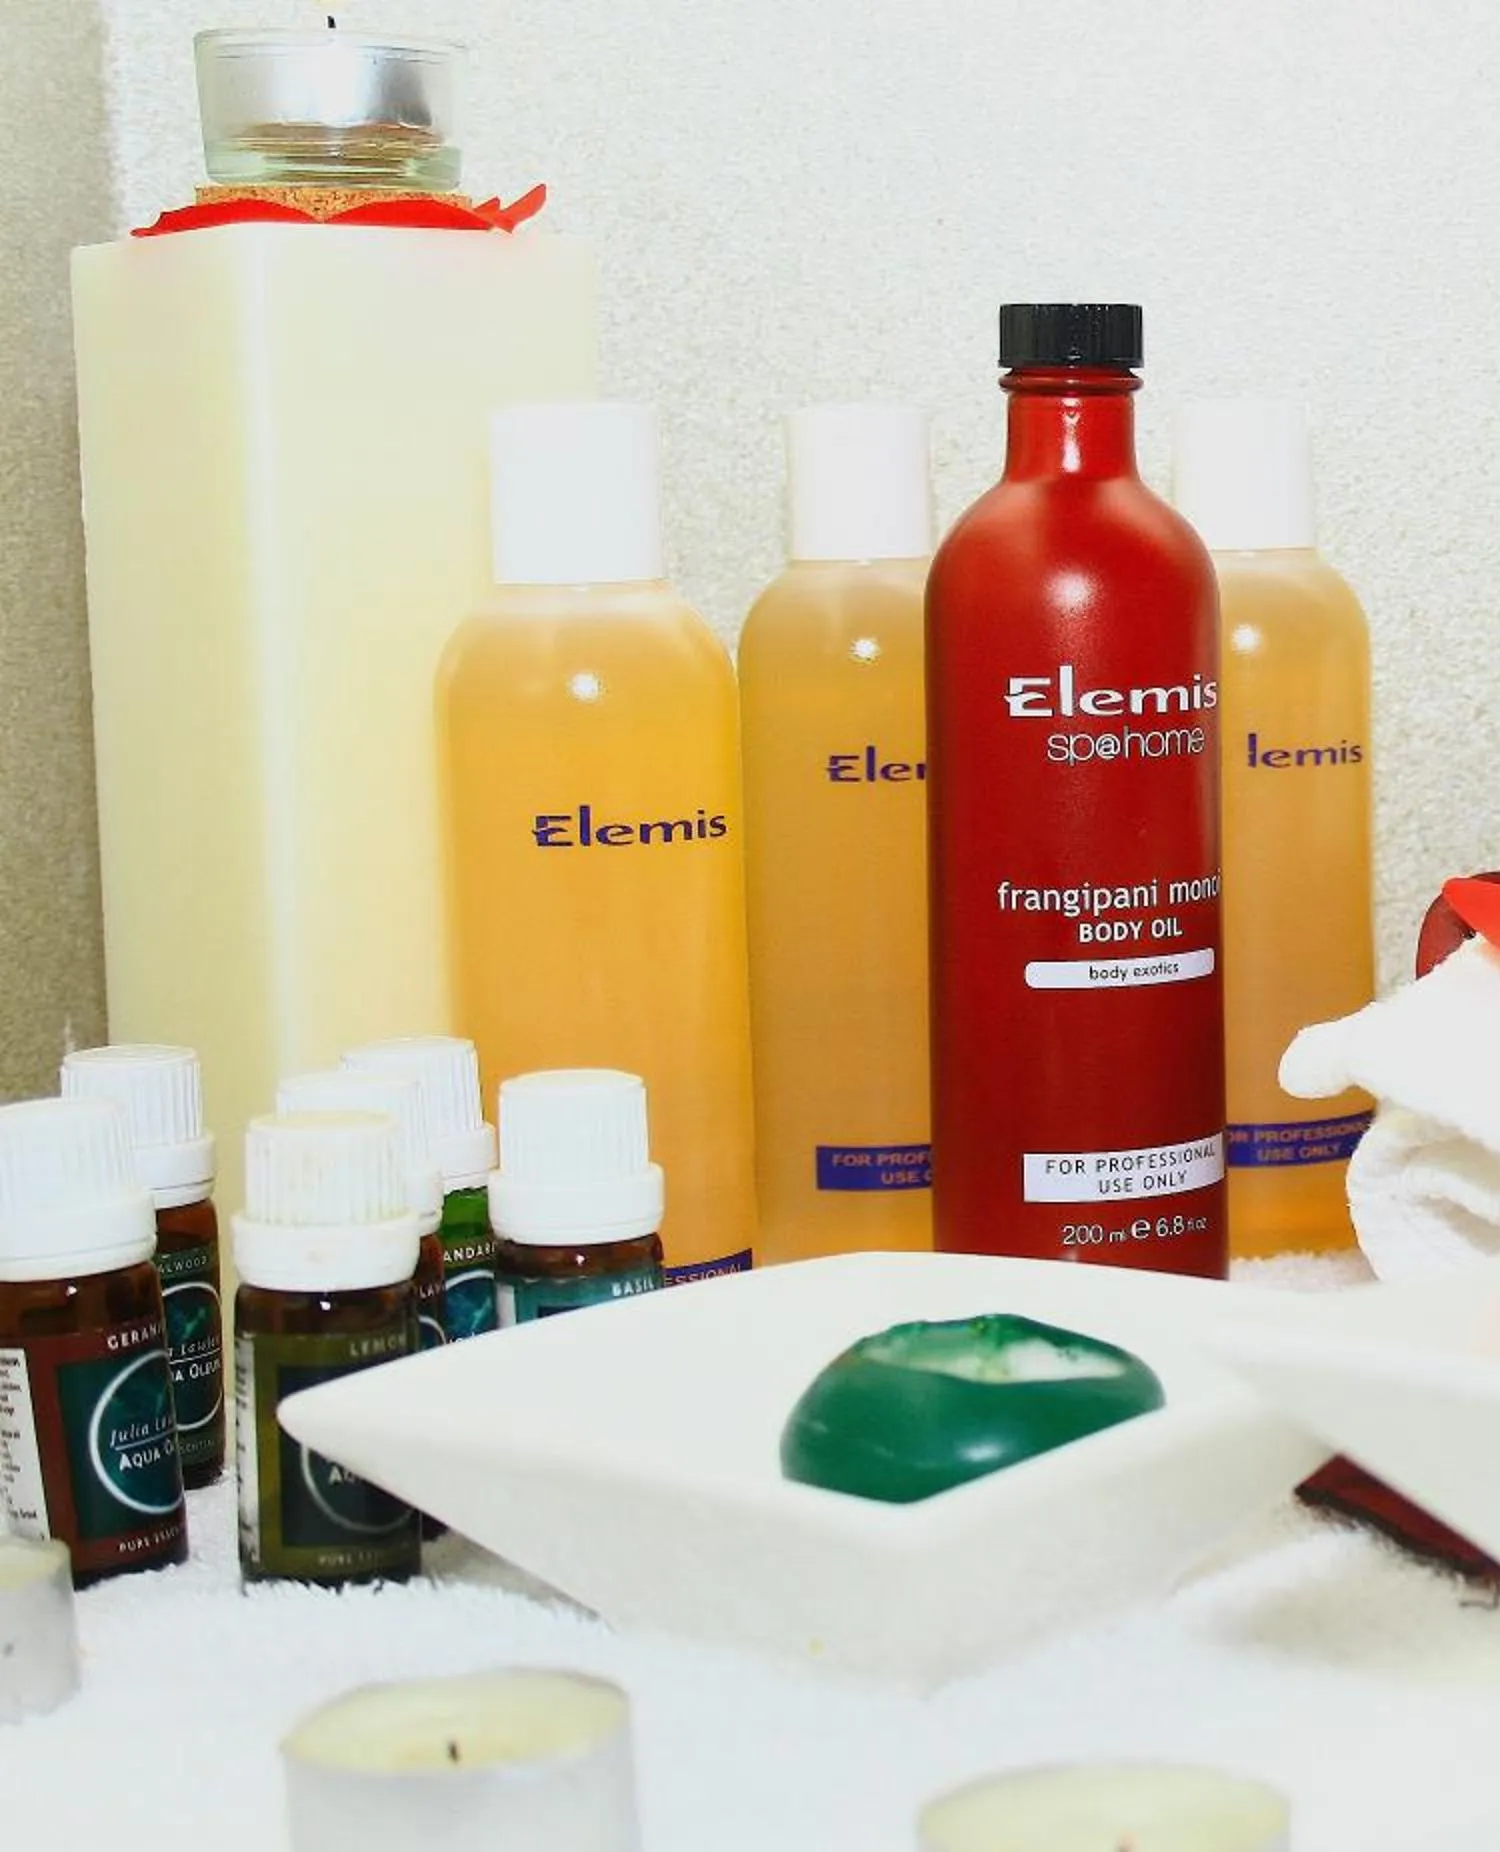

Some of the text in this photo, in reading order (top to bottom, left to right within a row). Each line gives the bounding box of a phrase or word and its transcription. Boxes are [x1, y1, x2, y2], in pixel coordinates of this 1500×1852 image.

[1003, 665, 1218, 717] Elemis
[1047, 726, 1205, 766] sp@home
[1247, 732, 1363, 768] lemis
[532, 804, 728, 847] Elemis
[997, 880, 1158, 917] frangipani
[1079, 917, 1183, 943] BODY OIL
[1089, 961, 1179, 987] body exotics
[832, 1151, 929, 1168] FOR PROF
[1045, 1143, 1216, 1175] FOR PROFESSIONAL
[881, 1170, 920, 1185] USE
[1099, 1170, 1188, 1194] USE ONLY
[1062, 1224, 1103, 1245] 200
[1156, 1215, 1185, 1237] 6.8
[443, 1243, 497, 1262] ANDARI
[611, 1278, 655, 1297] BASIL
[107, 1322, 163, 1350] GERANI
[351, 1335, 407, 1356] LEMON
[119, 1448, 161, 1472] AQUA
